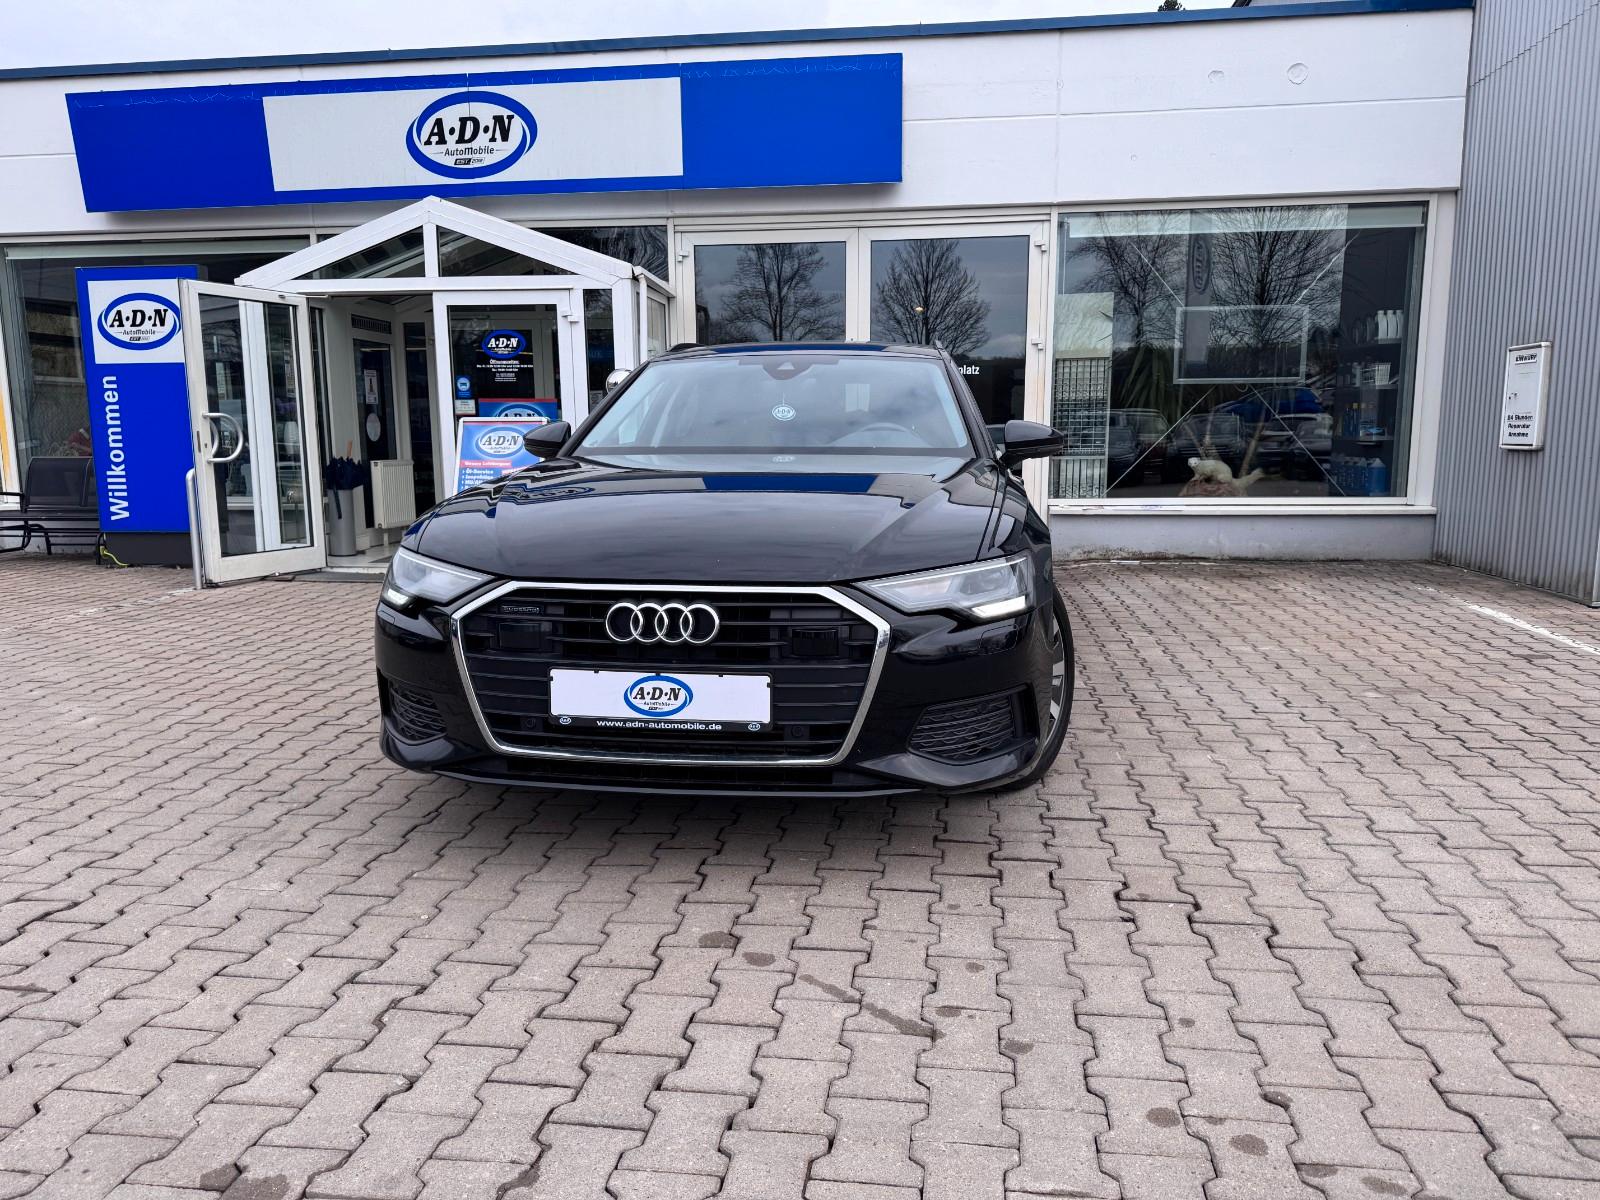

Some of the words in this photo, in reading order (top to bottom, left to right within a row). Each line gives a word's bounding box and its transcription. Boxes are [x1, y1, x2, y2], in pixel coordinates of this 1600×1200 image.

[424, 114, 514, 146] A·D·N
[109, 309, 168, 328] A·D·N
[488, 338, 518, 348] A·D·N
[102, 376, 130, 520] Willkommen
[633, 687, 682, 701] A·D·N
[596, 720, 722, 730] www.adn-automobile.de
